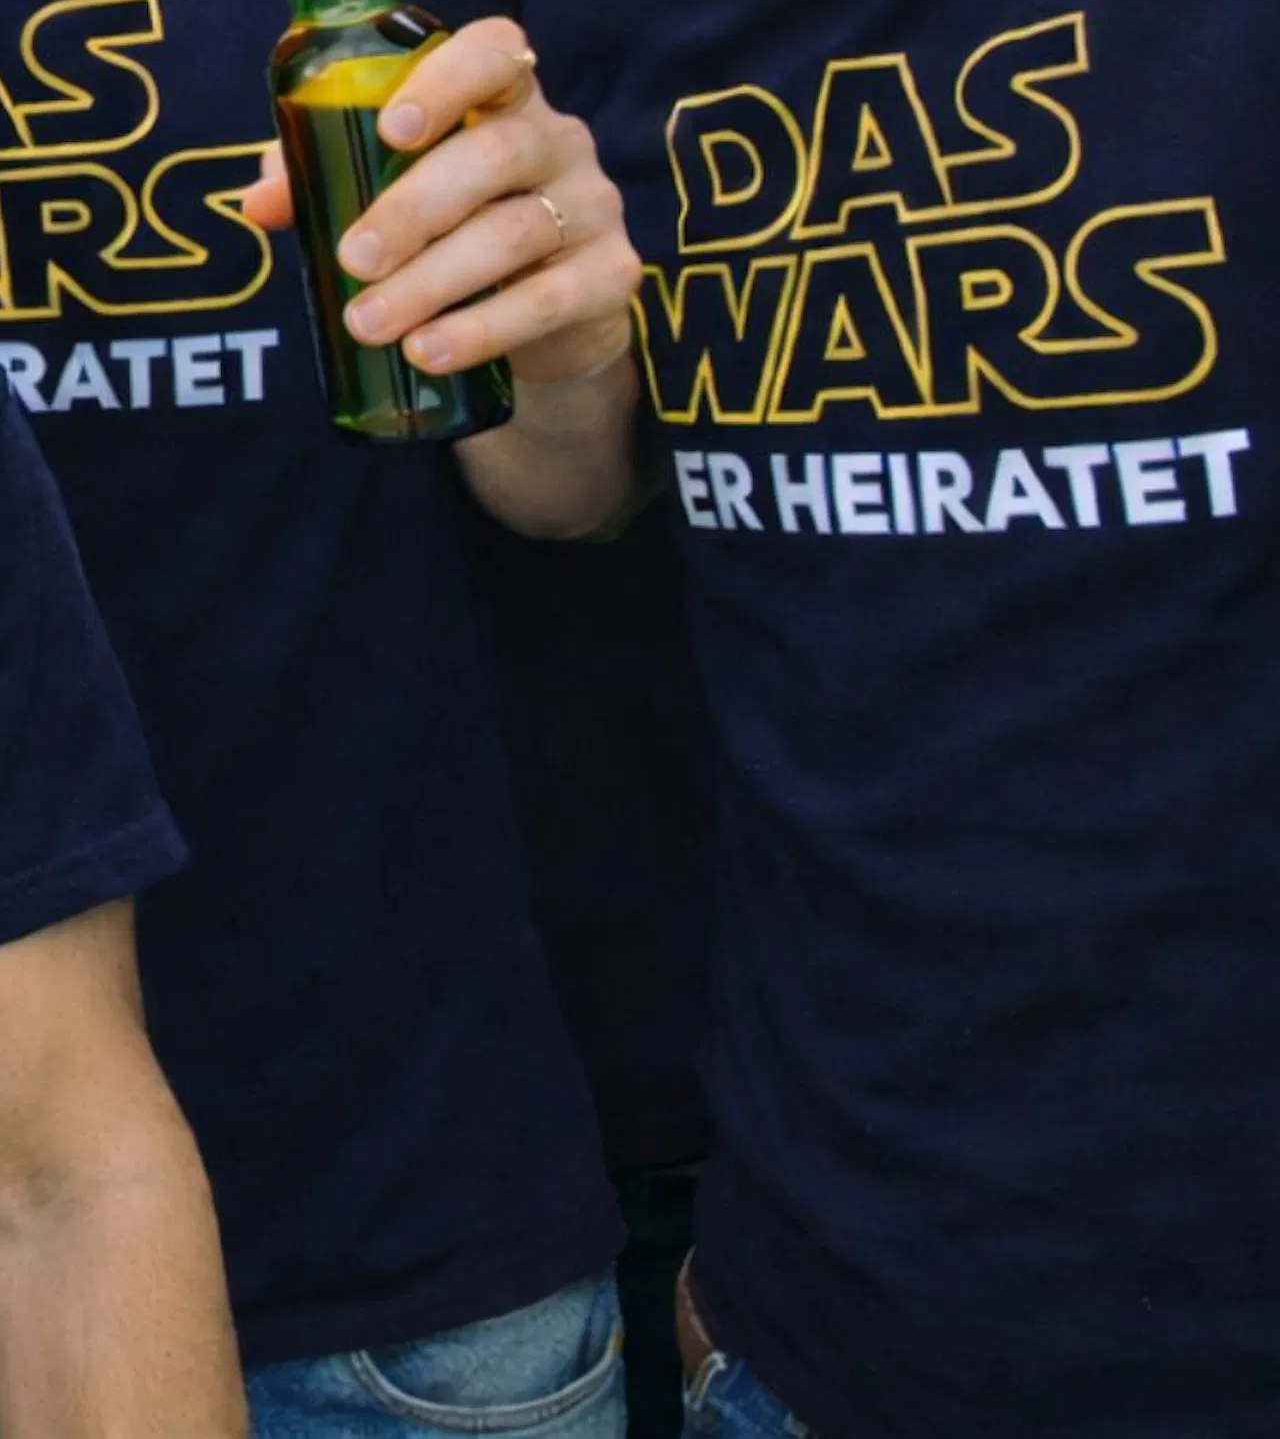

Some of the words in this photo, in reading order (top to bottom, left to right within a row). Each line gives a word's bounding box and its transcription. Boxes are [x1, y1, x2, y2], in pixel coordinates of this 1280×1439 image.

[666, 11, 1089, 254] DAS
[629, 196, 1227, 425] WARS
[674, 451, 763, 531] ER
[771, 428, 1250, 535] HEIRATET
